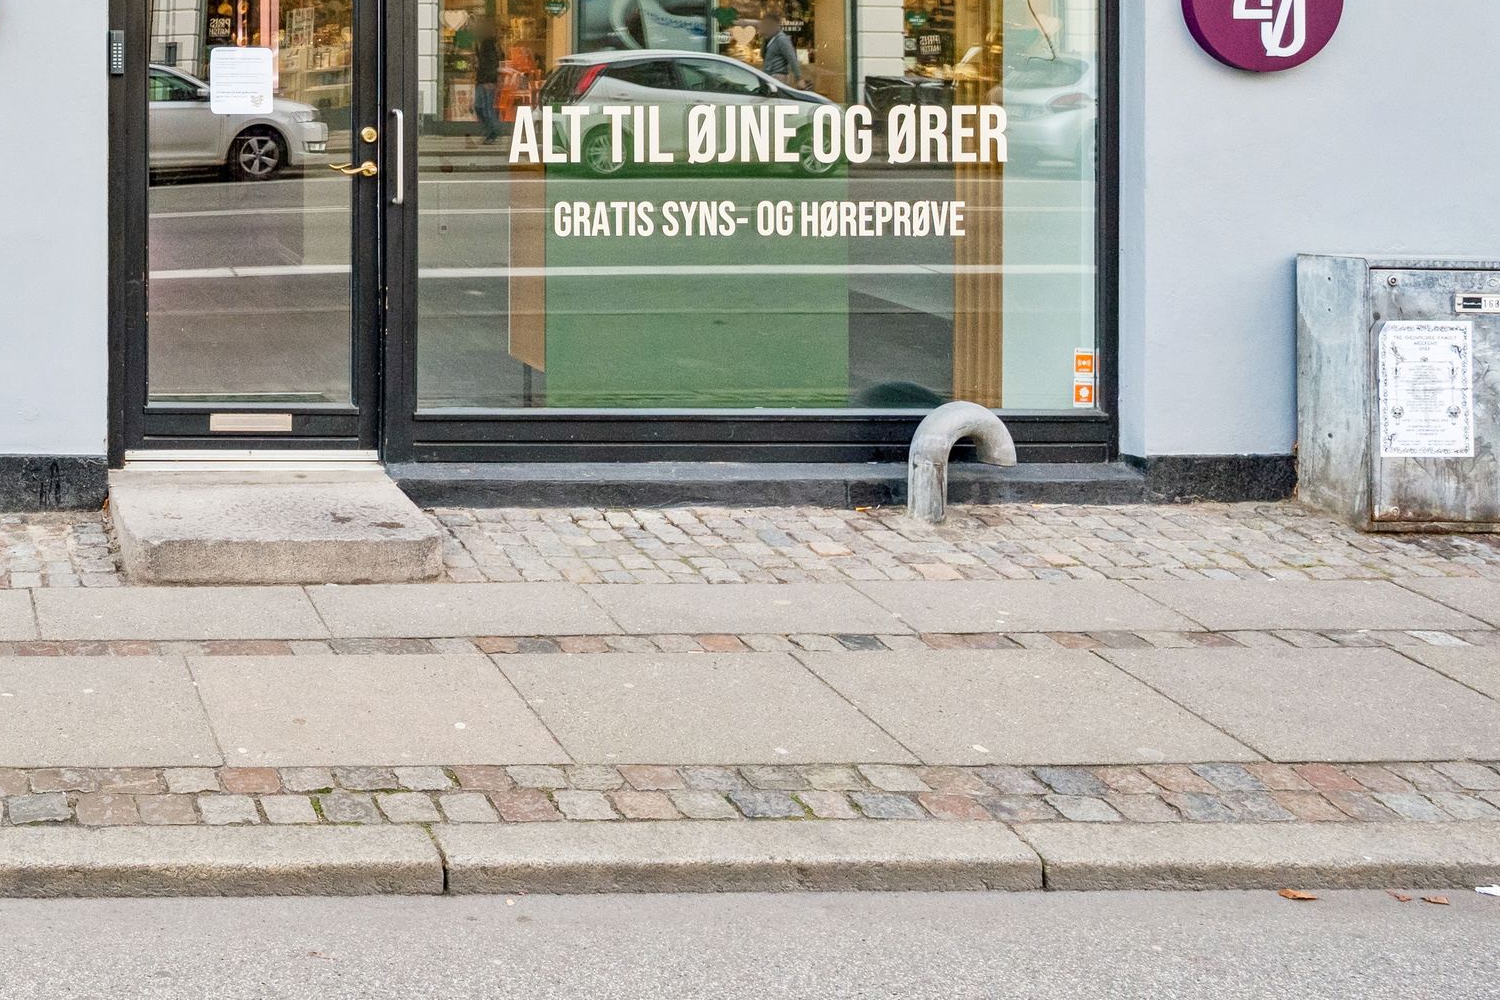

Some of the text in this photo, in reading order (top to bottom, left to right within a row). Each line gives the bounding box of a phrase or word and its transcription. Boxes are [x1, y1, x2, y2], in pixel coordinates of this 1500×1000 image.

[508, 103, 1009, 164] ALT TIL ØJNE OG ØRER
[553, 200, 966, 237] GRATIS SYNS- OG HØREPRØVE
